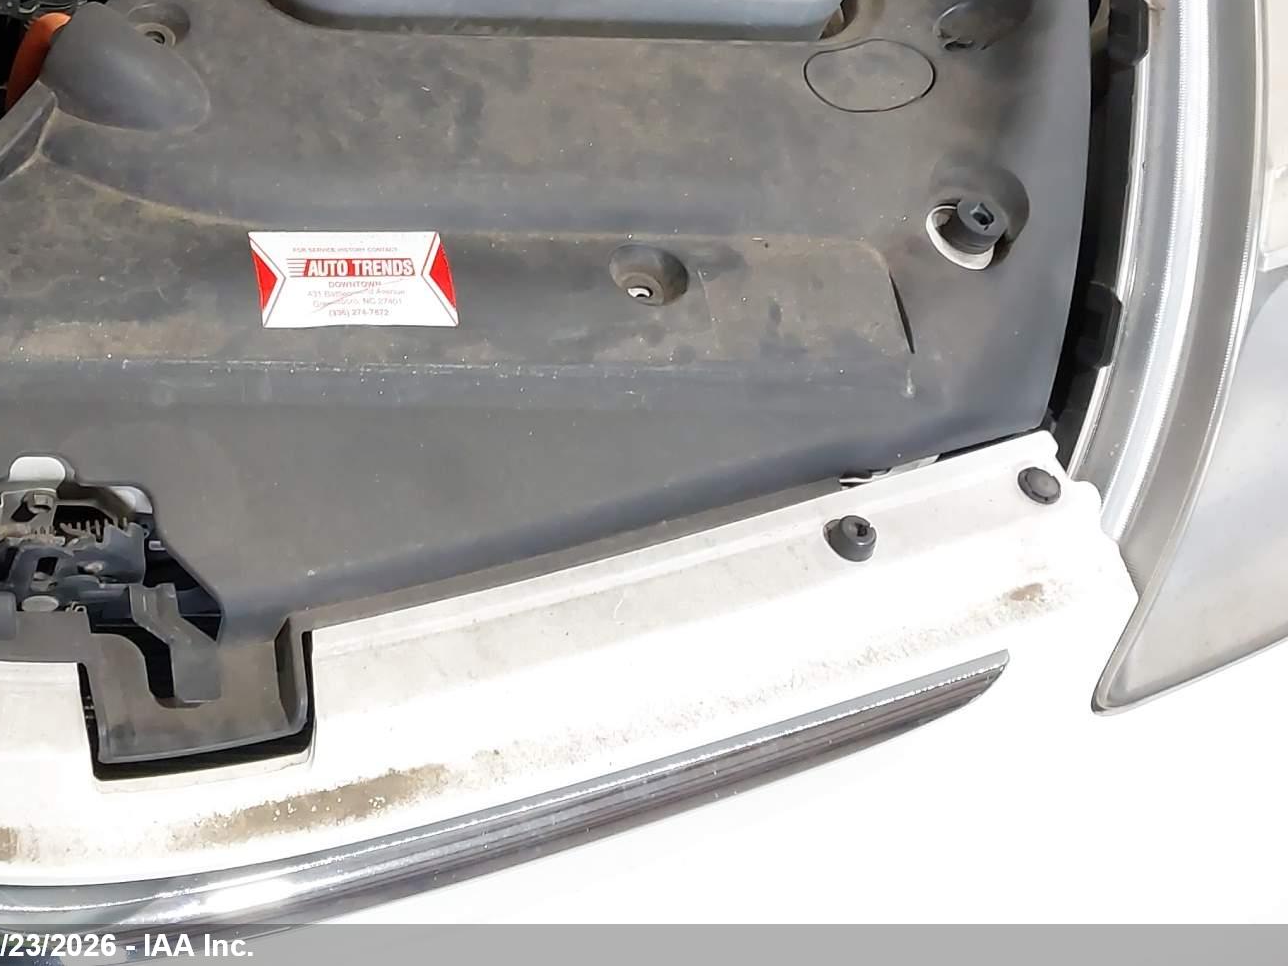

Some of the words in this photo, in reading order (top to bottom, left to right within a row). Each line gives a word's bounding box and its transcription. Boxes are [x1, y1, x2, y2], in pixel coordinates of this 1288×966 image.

[308, 259, 348, 276] AUTO
[352, 259, 414, 276] TRENDS
[328, 280, 382, 289] DOWNTOWN
